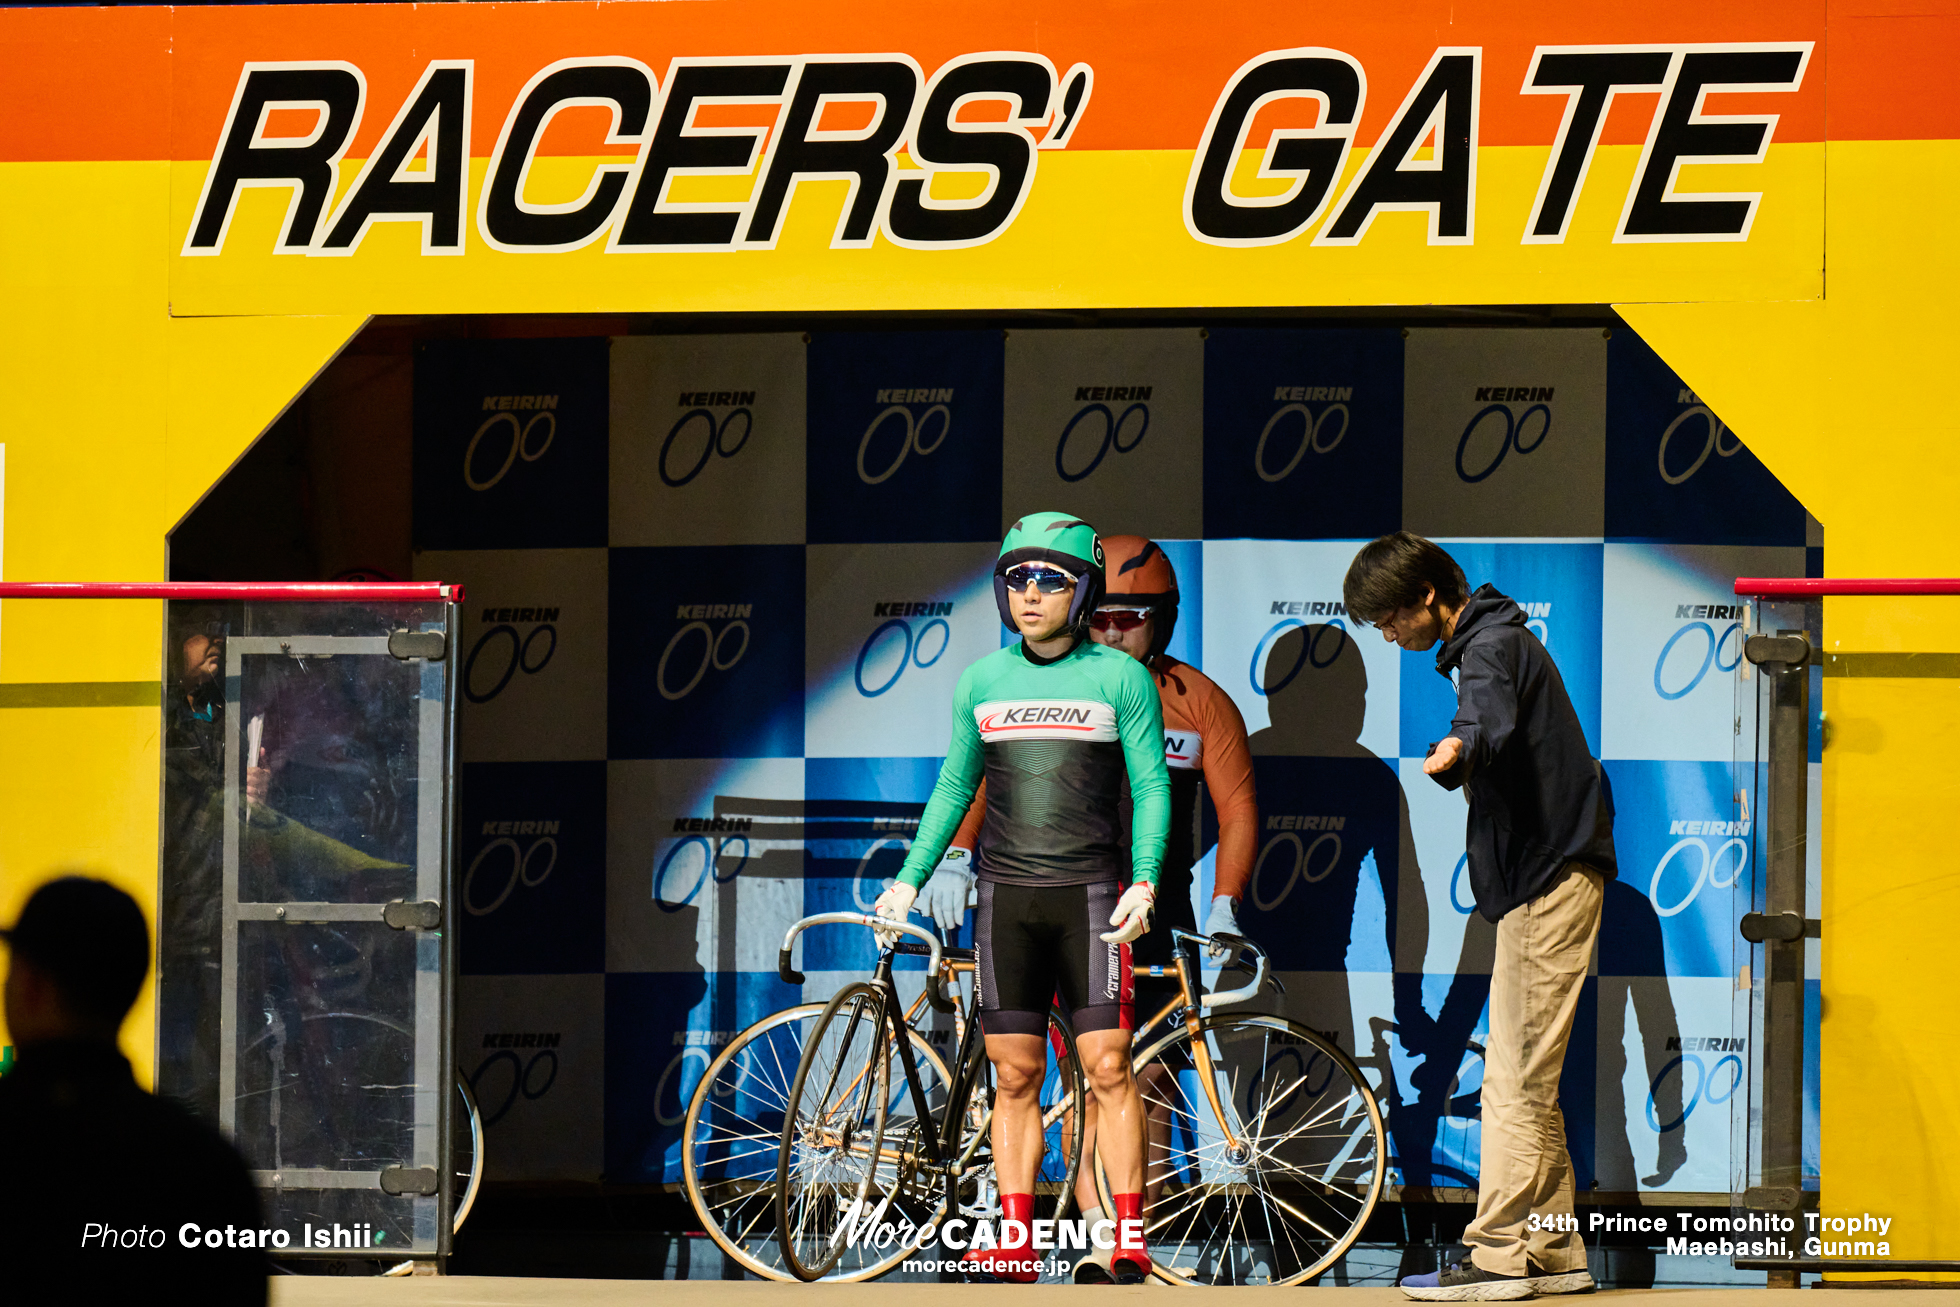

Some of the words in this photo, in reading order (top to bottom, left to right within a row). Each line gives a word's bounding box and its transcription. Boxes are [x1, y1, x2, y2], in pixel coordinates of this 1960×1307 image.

[181, 52, 1093, 257] RACERS'
[1183, 41, 1815, 247] GATE
[679, 392, 755, 406] KEIRIN
[876, 388, 953, 403] KEIRIN
[1074, 387, 1152, 401] KEIRIN
[1274, 386, 1352, 401] KEIRIN
[1475, 387, 1554, 402] KEIRIN
[482, 395, 558, 410] KEIRIN
[481, 608, 558, 622] KEIRIN
[677, 604, 752, 618] KEIRIN
[874, 602, 952, 616] KEIRIN
[1003, 707, 1091, 724] KEIRIN
[482, 821, 559, 835] KEIRIN
[673, 818, 752, 832] KEIRIN
[1266, 816, 1345, 830] KEIRIN
[1670, 821, 1750, 836] KEIRIN
[482, 1032, 560, 1046] KEIRIN
[1665, 1037, 1746, 1052] KEIRIN
